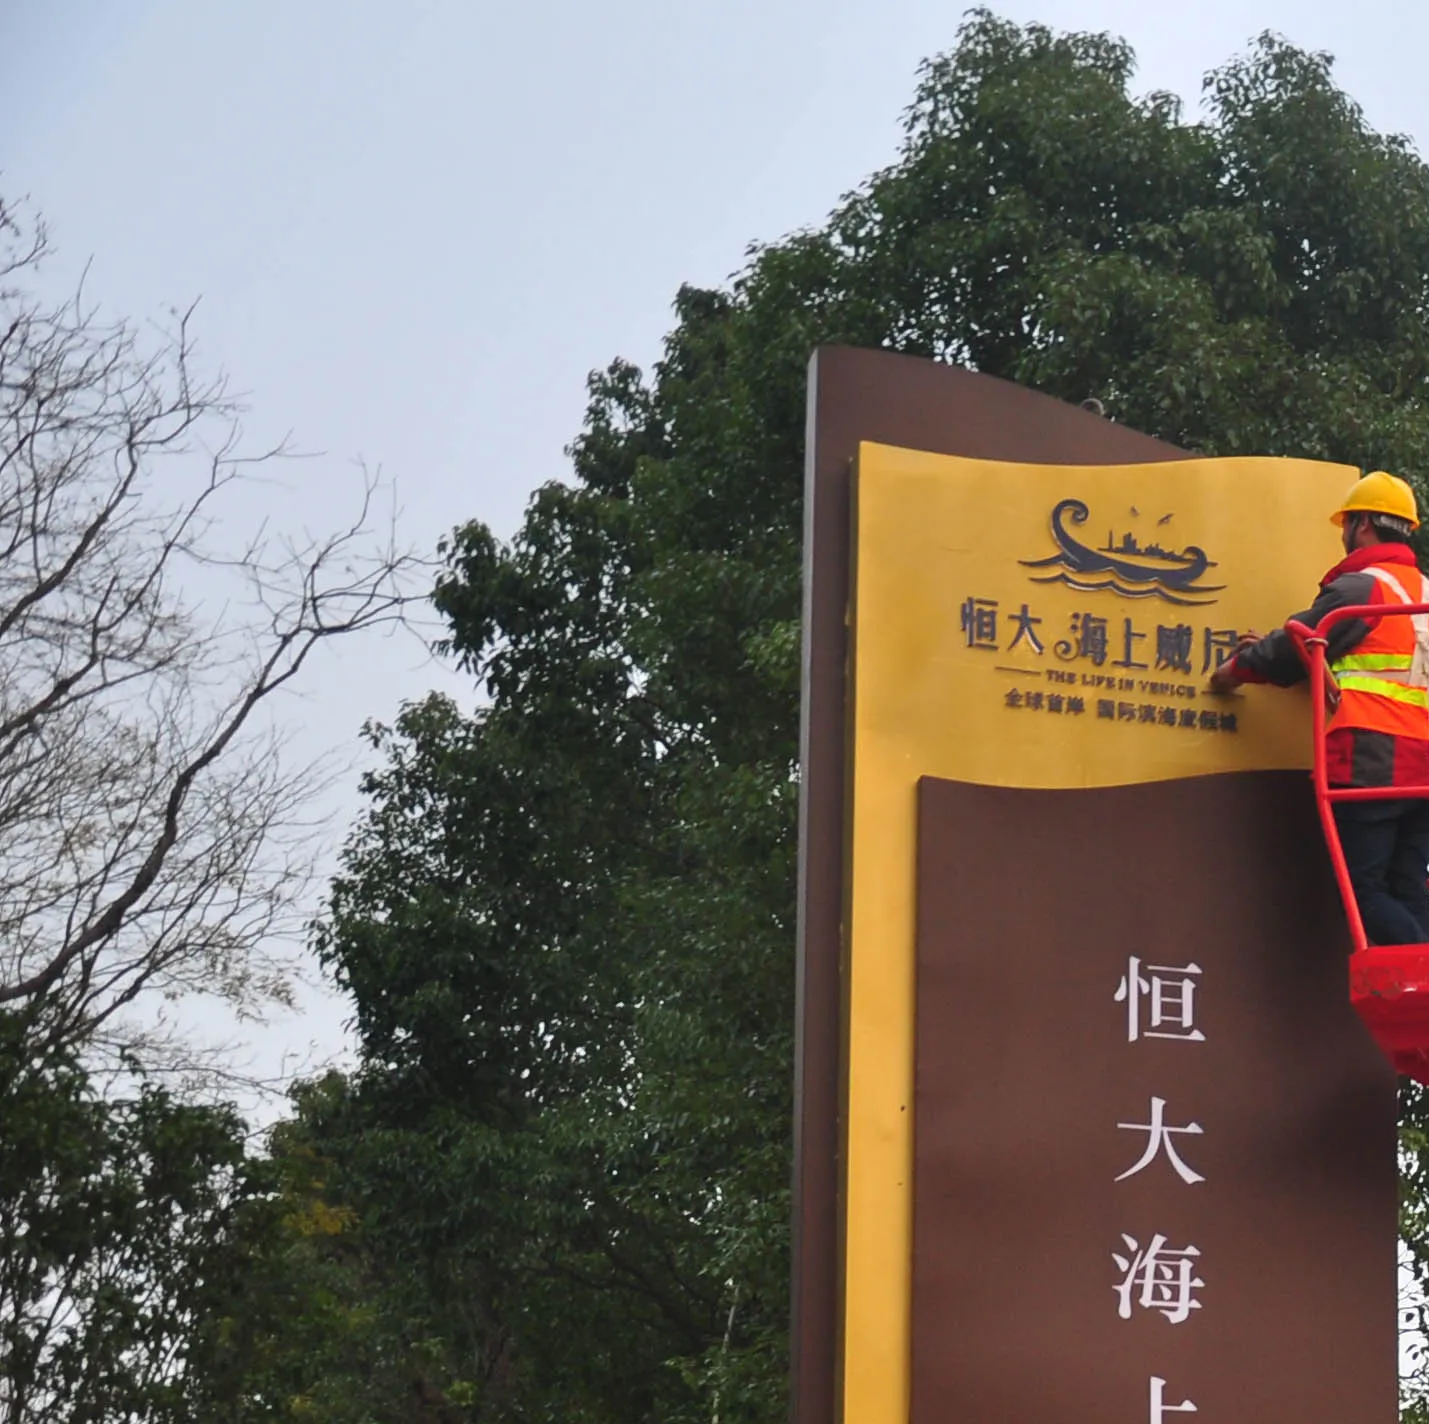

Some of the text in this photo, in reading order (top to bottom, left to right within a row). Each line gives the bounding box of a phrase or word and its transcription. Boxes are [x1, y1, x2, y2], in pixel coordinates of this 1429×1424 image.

[1046, 669, 1197, 699] THE LIFE IN VENICE
